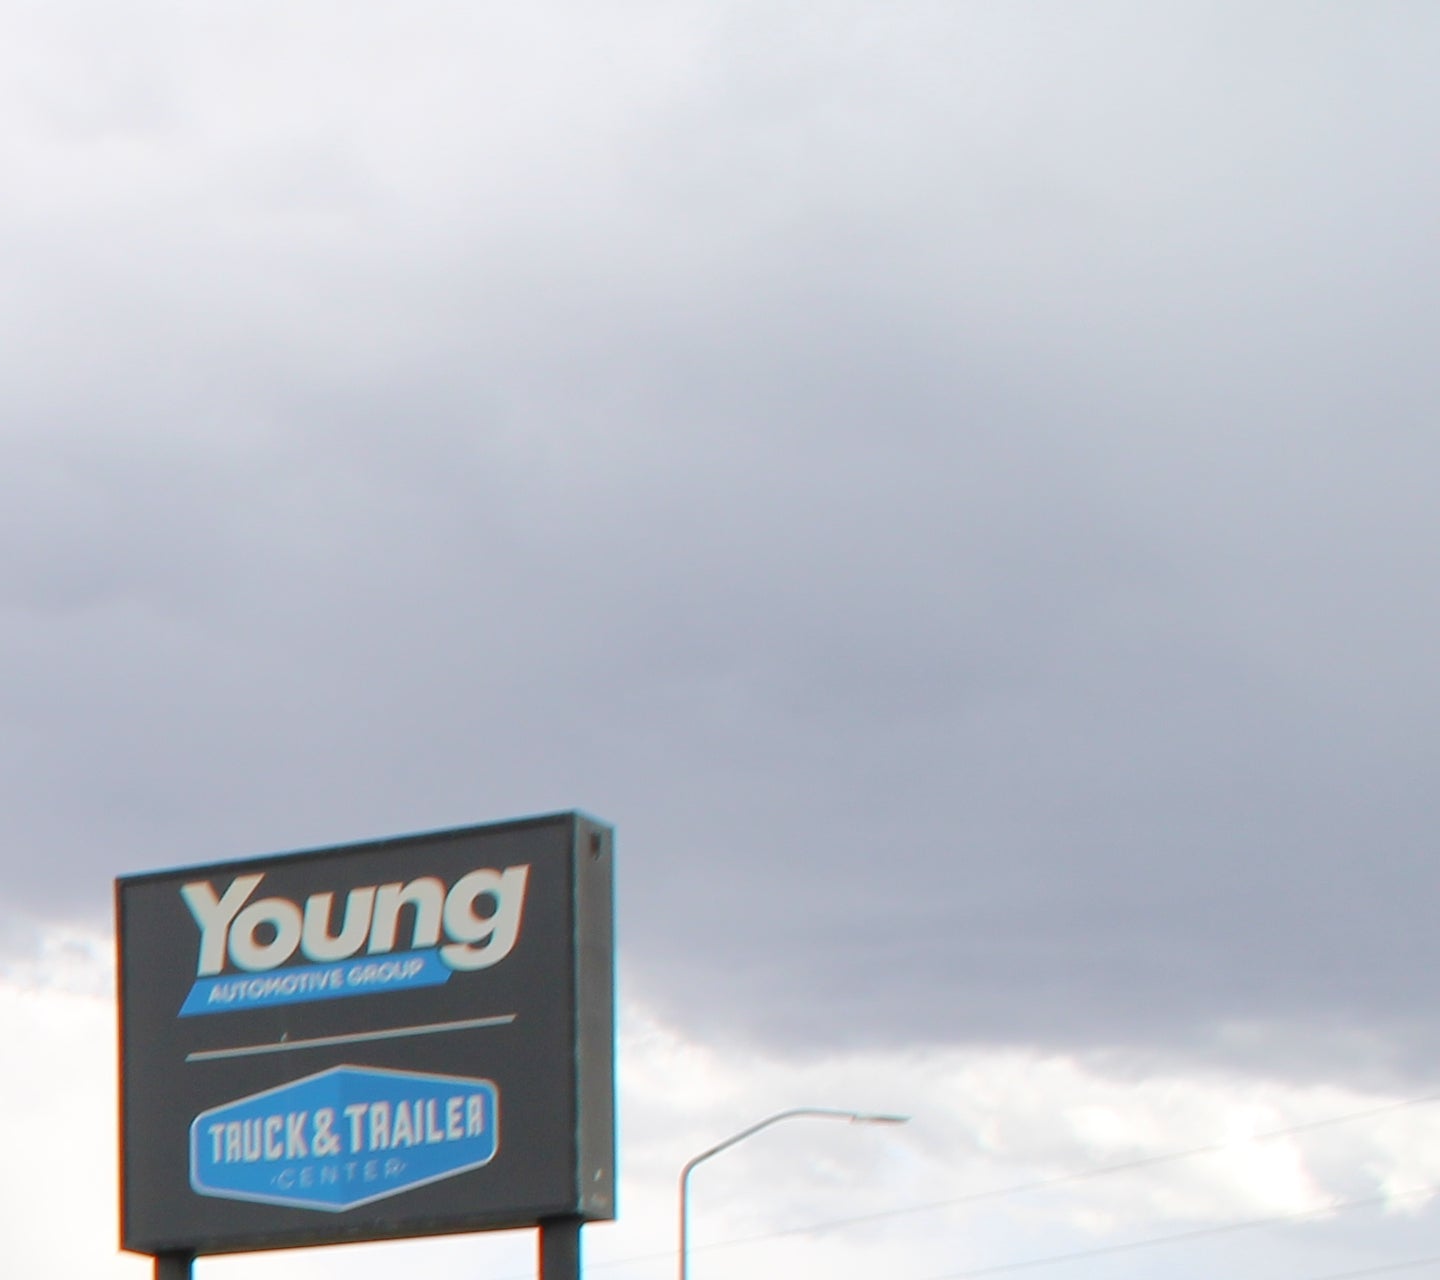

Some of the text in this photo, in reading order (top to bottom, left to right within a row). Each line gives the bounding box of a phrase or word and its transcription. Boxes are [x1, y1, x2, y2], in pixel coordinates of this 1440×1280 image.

[181, 863, 530, 977] Young
[208, 959, 424, 1004] AUTOMOTIVE GROUP
[208, 1095, 485, 1164] TRUCK & TRAILER
[277, 1158, 402, 1188] CENTER
